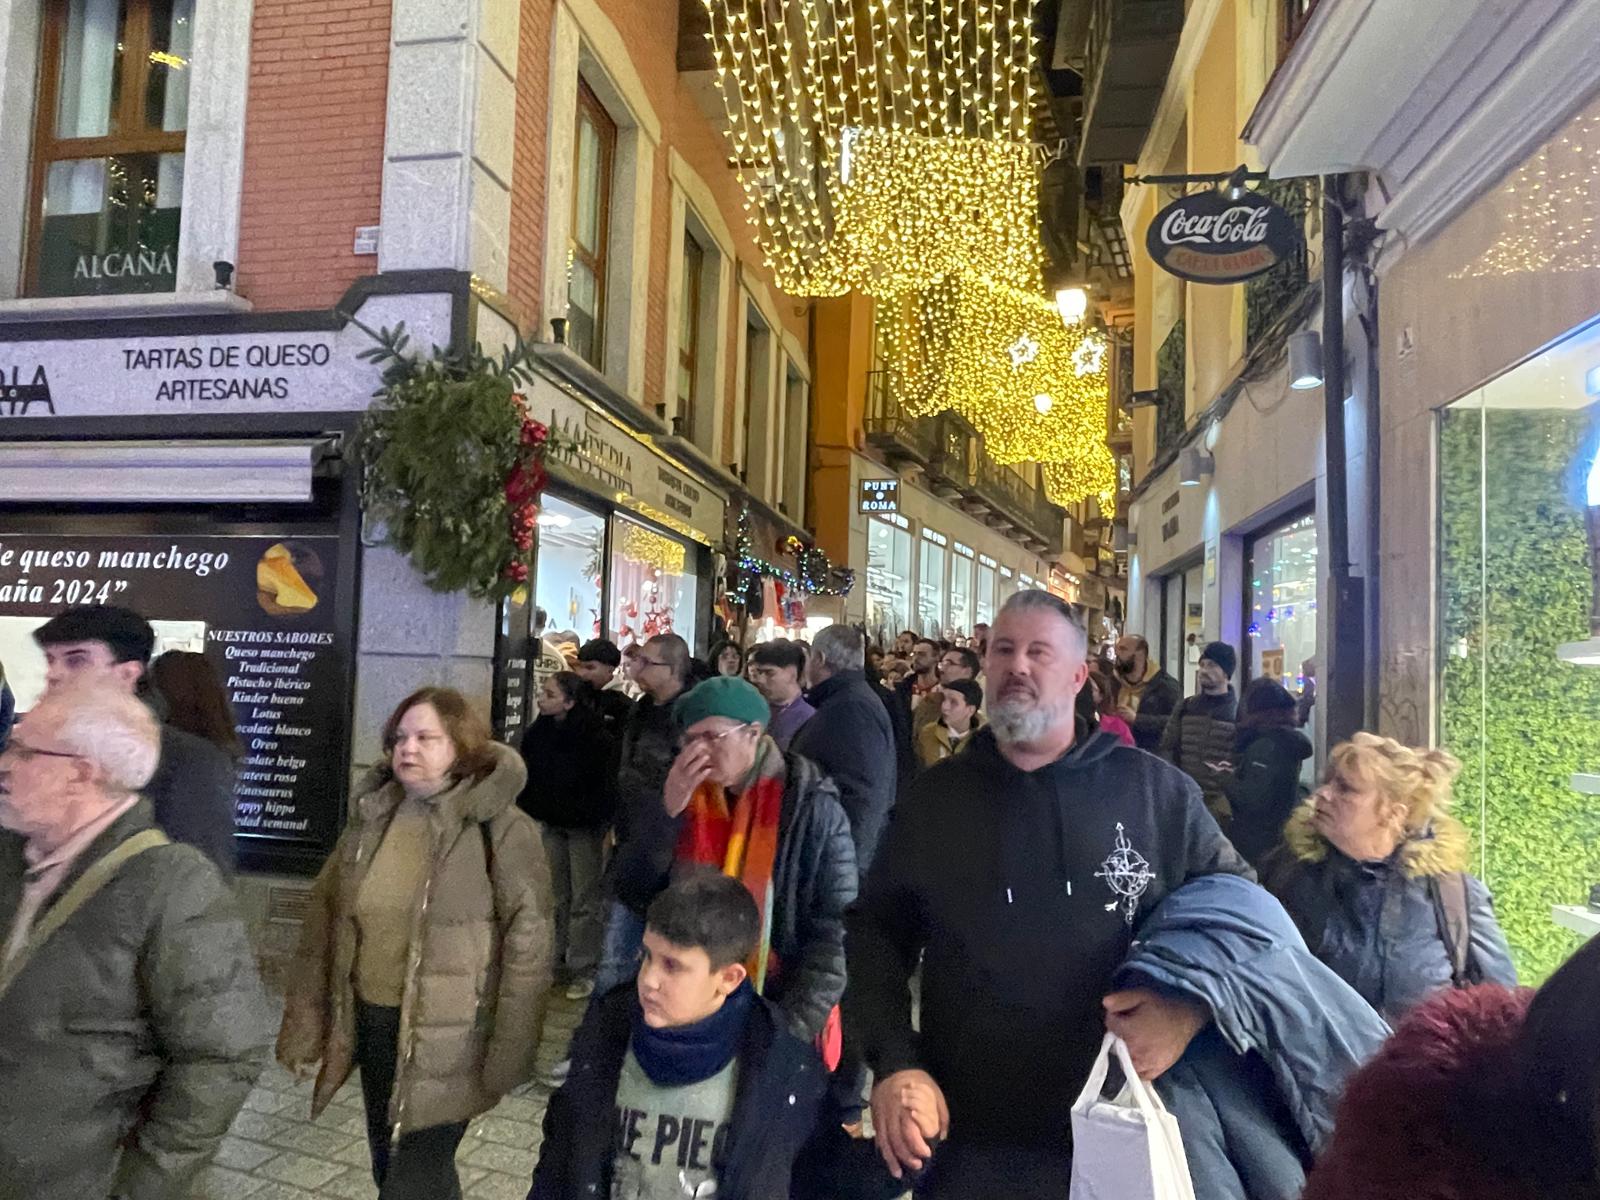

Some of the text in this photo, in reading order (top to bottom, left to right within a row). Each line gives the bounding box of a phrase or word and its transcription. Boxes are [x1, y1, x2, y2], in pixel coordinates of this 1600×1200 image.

[1161, 206, 1271, 245] Coca-Cola
[123, 343, 330, 370] TARTAS DE QUESO
[156, 377, 289, 401] ARTESANAS
[864, 481, 897, 491] PUNT
[862, 501, 896, 510] ROMA
[0, 542, 229, 577] e queso manchego
[208, 630, 334, 644] NUESTROS SABORES
[225, 646, 316, 662] Queso manchego
[239, 661, 300, 674] Tradicional
[227, 676, 311, 690] Pistacho ibérico
[232, 691, 304, 705] Kinder bueno
[252, 707, 282, 719] Lotus
[235, 723, 311, 737] ocolate blanco
[251, 738, 278, 750] Oreo
[276, 755, 306, 770] belga
[274, 774, 297, 783] rosa
[236, 801, 295, 816] appy hippo
[263, 819, 308, 831] semanal
